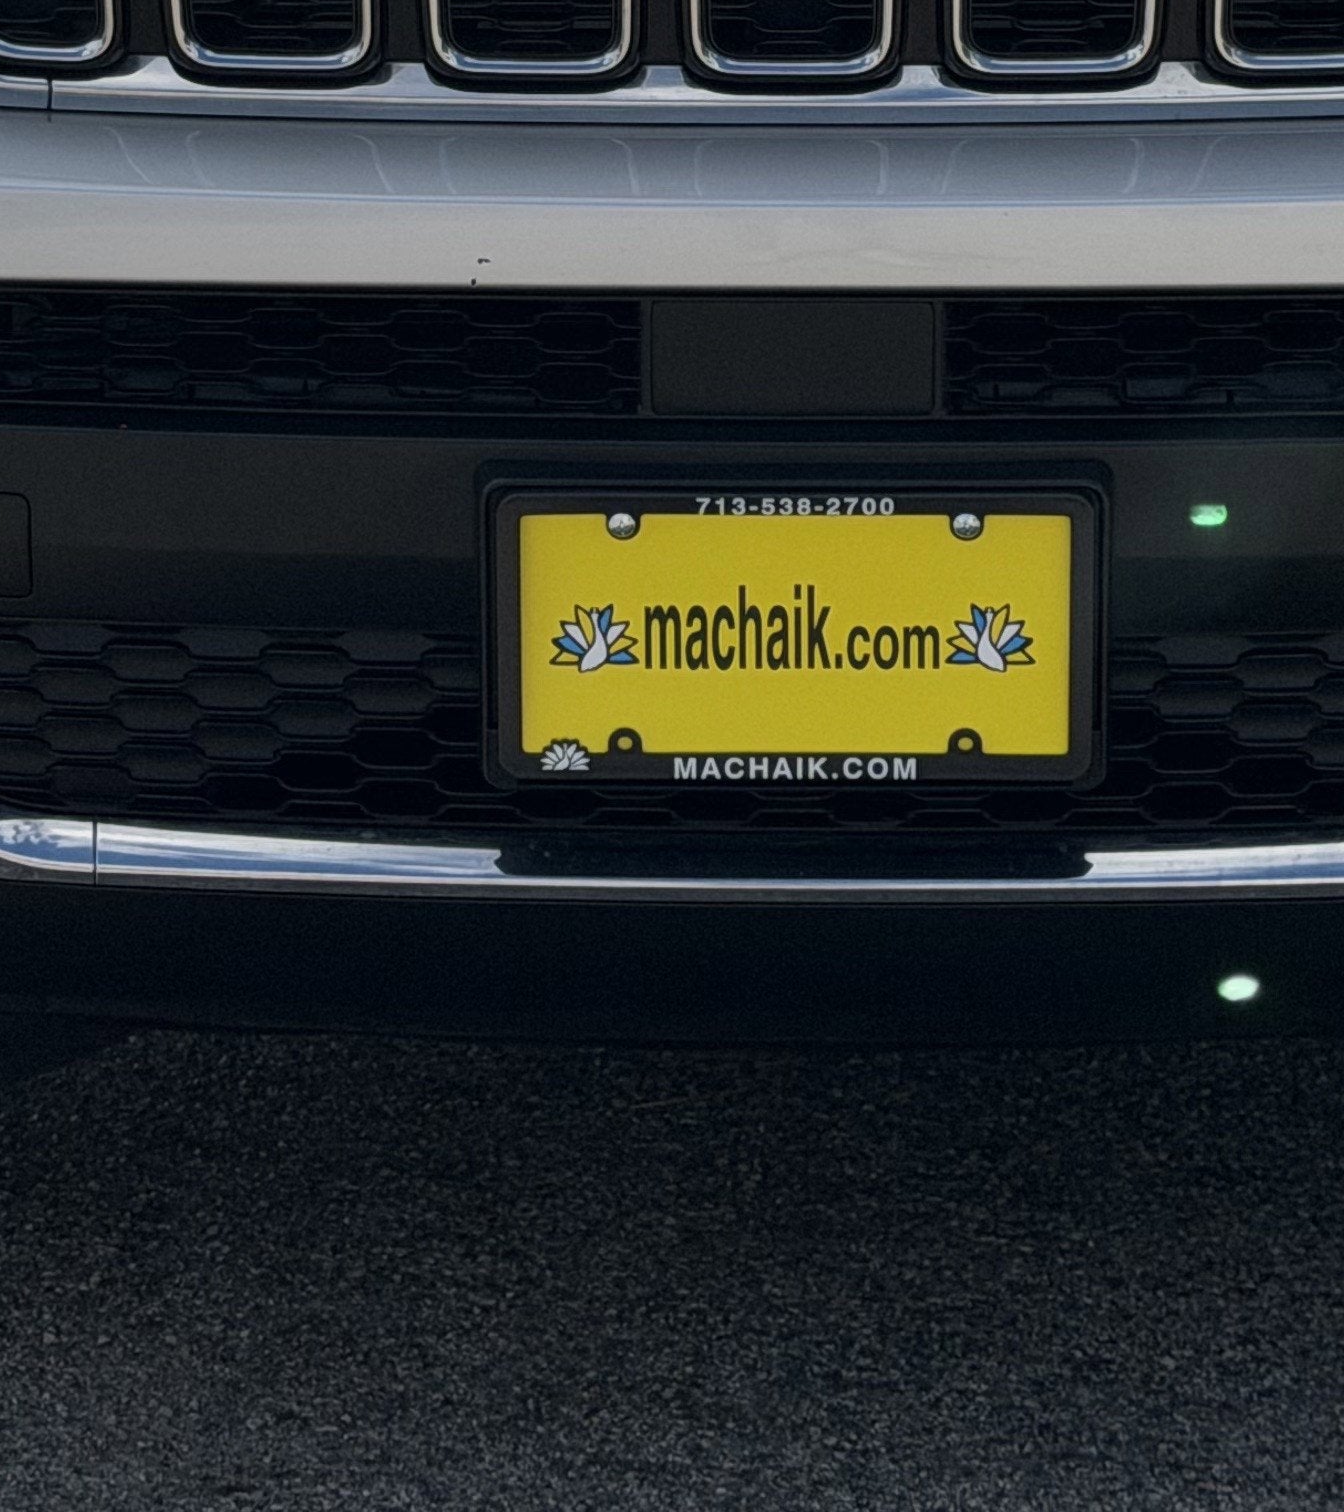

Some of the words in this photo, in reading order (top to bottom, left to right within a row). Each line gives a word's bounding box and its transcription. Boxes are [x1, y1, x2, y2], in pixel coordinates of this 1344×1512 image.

[695, 497, 895, 516] 713-538-2700
[643, 584, 941, 670] machaik.com
[673, 757, 918, 780] MACHAIK.COM
